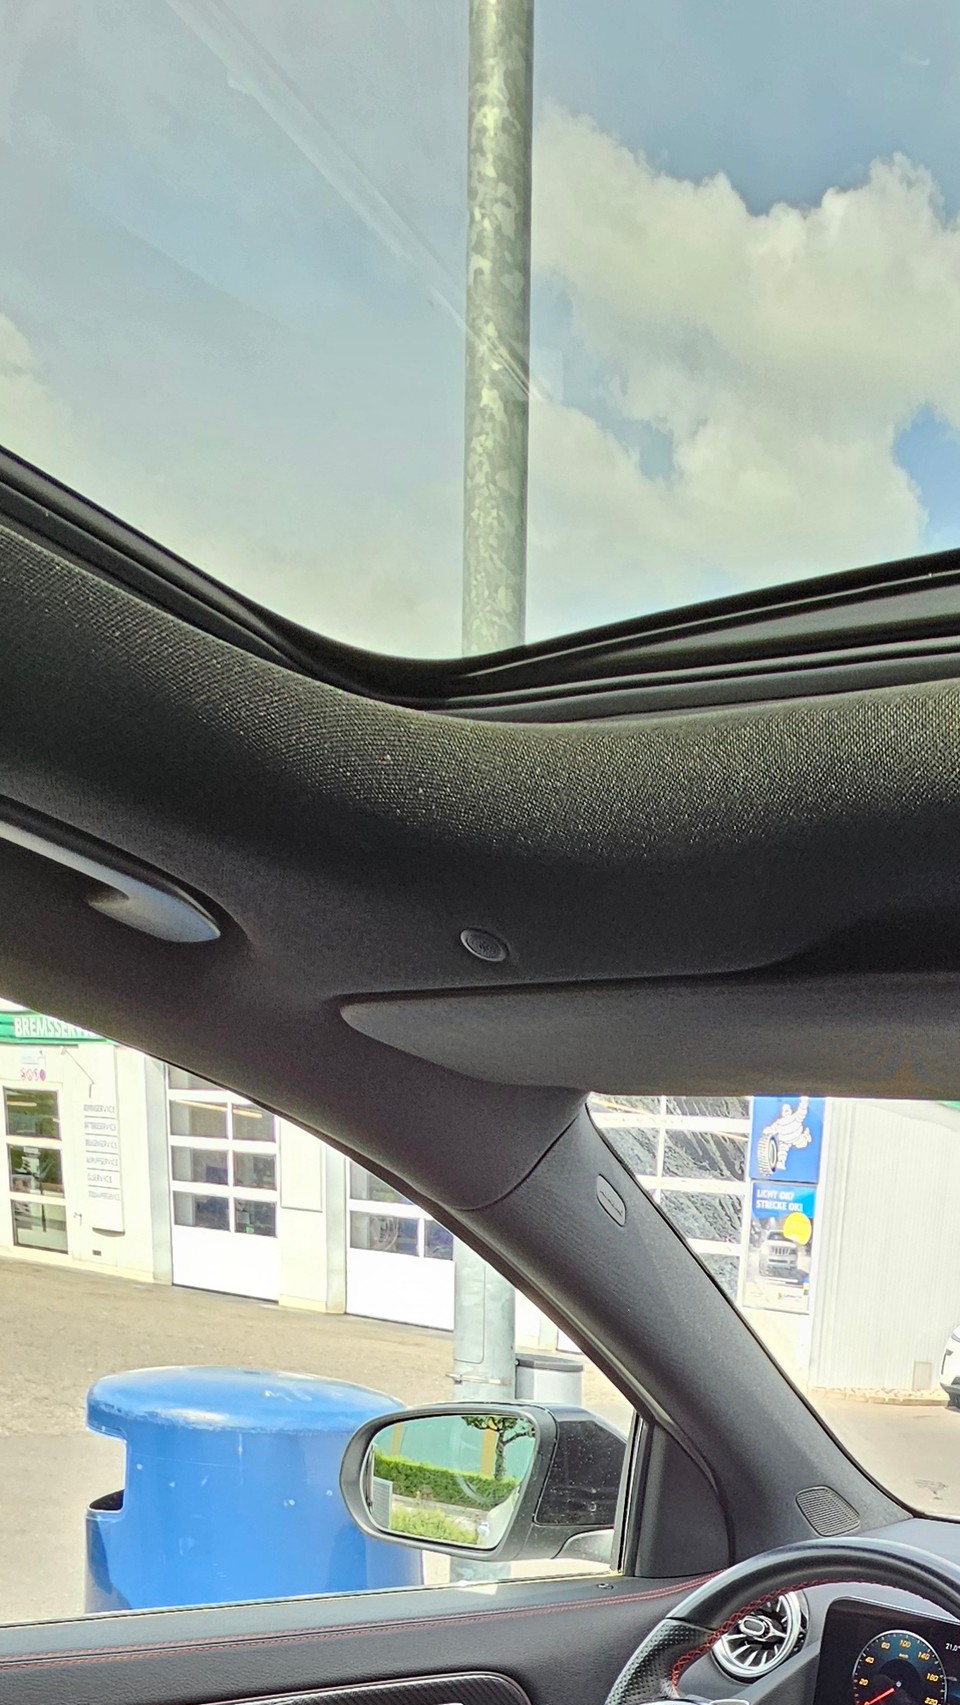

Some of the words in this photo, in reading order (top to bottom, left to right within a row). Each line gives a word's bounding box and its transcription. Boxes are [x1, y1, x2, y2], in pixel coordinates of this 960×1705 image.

[900, 1640, 911, 1648] 100
[918, 1652, 930, 1660] 140
[924, 1697, 938, 1705] 220
